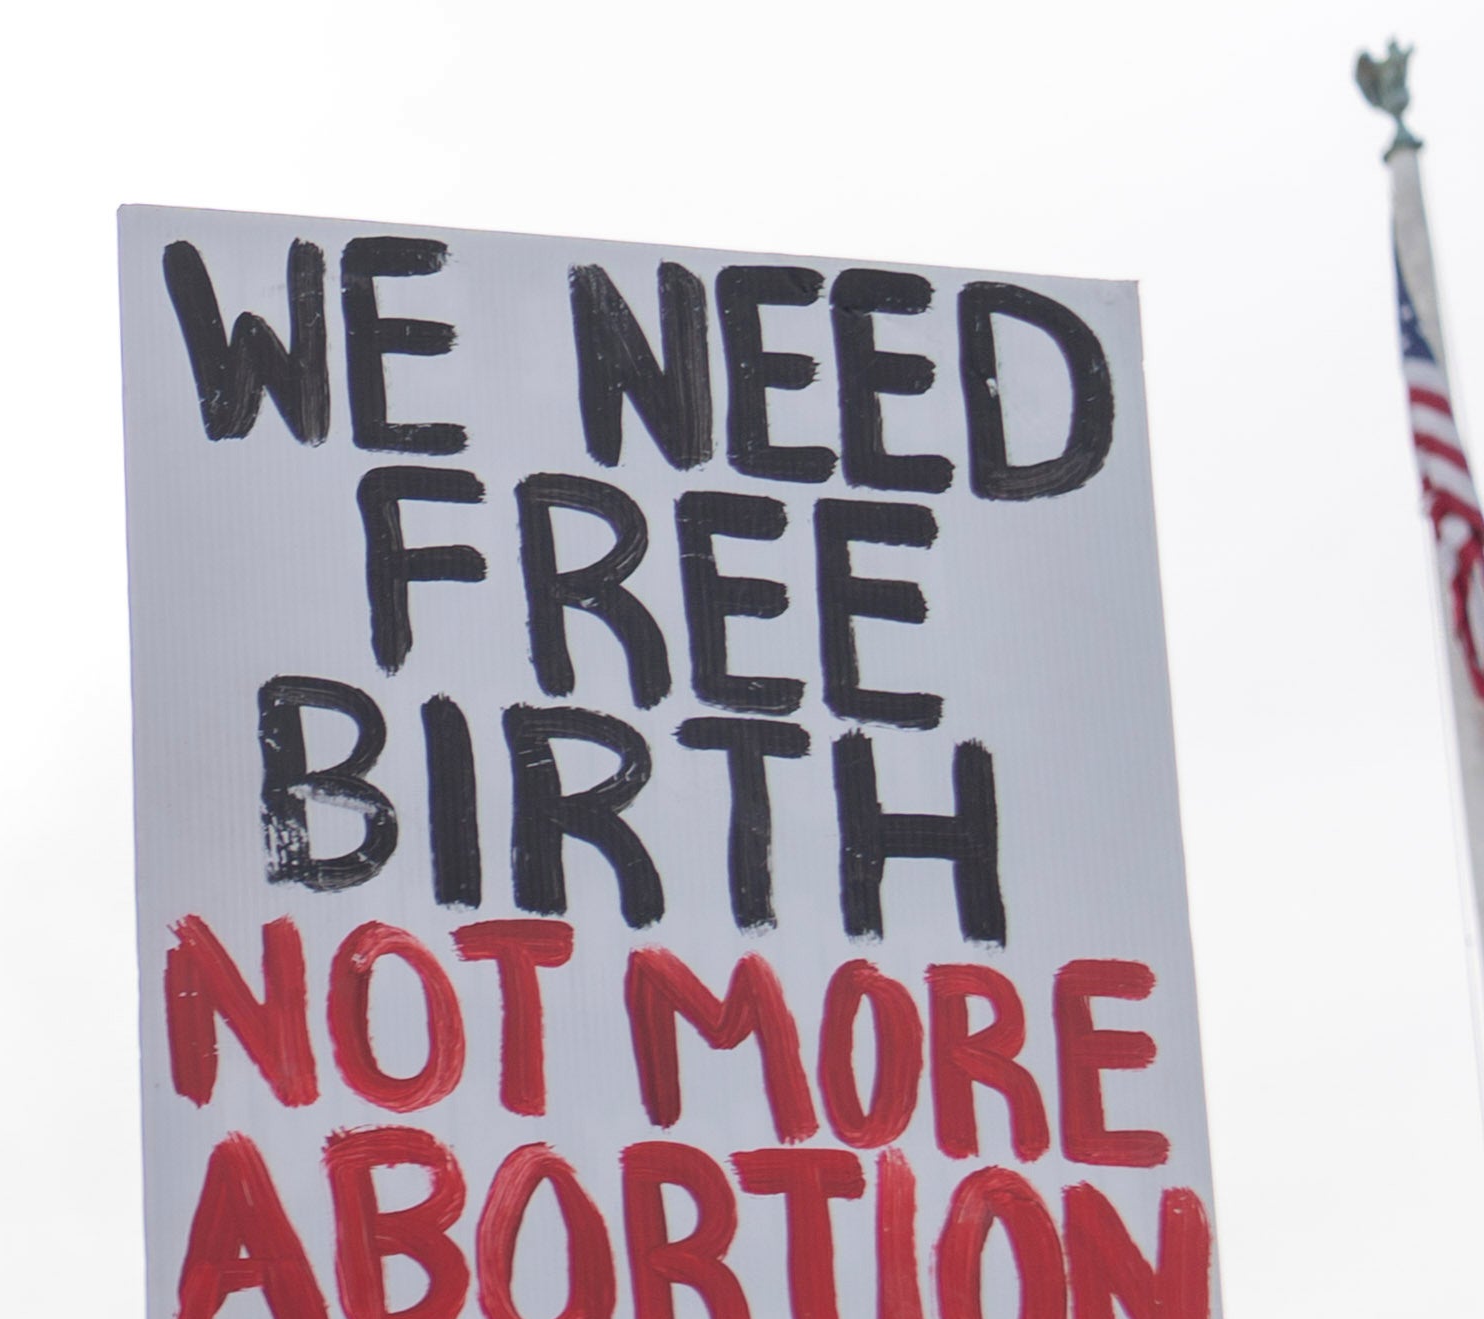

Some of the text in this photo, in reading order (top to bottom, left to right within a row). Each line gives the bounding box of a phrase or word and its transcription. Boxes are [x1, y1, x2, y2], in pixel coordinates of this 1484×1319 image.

[163, 234, 1115, 500] WE NEED
[356, 464, 945, 731] FREE
[257, 676, 1007, 950] BIRTH
[165, 915, 1170, 1166] NOT MORE
